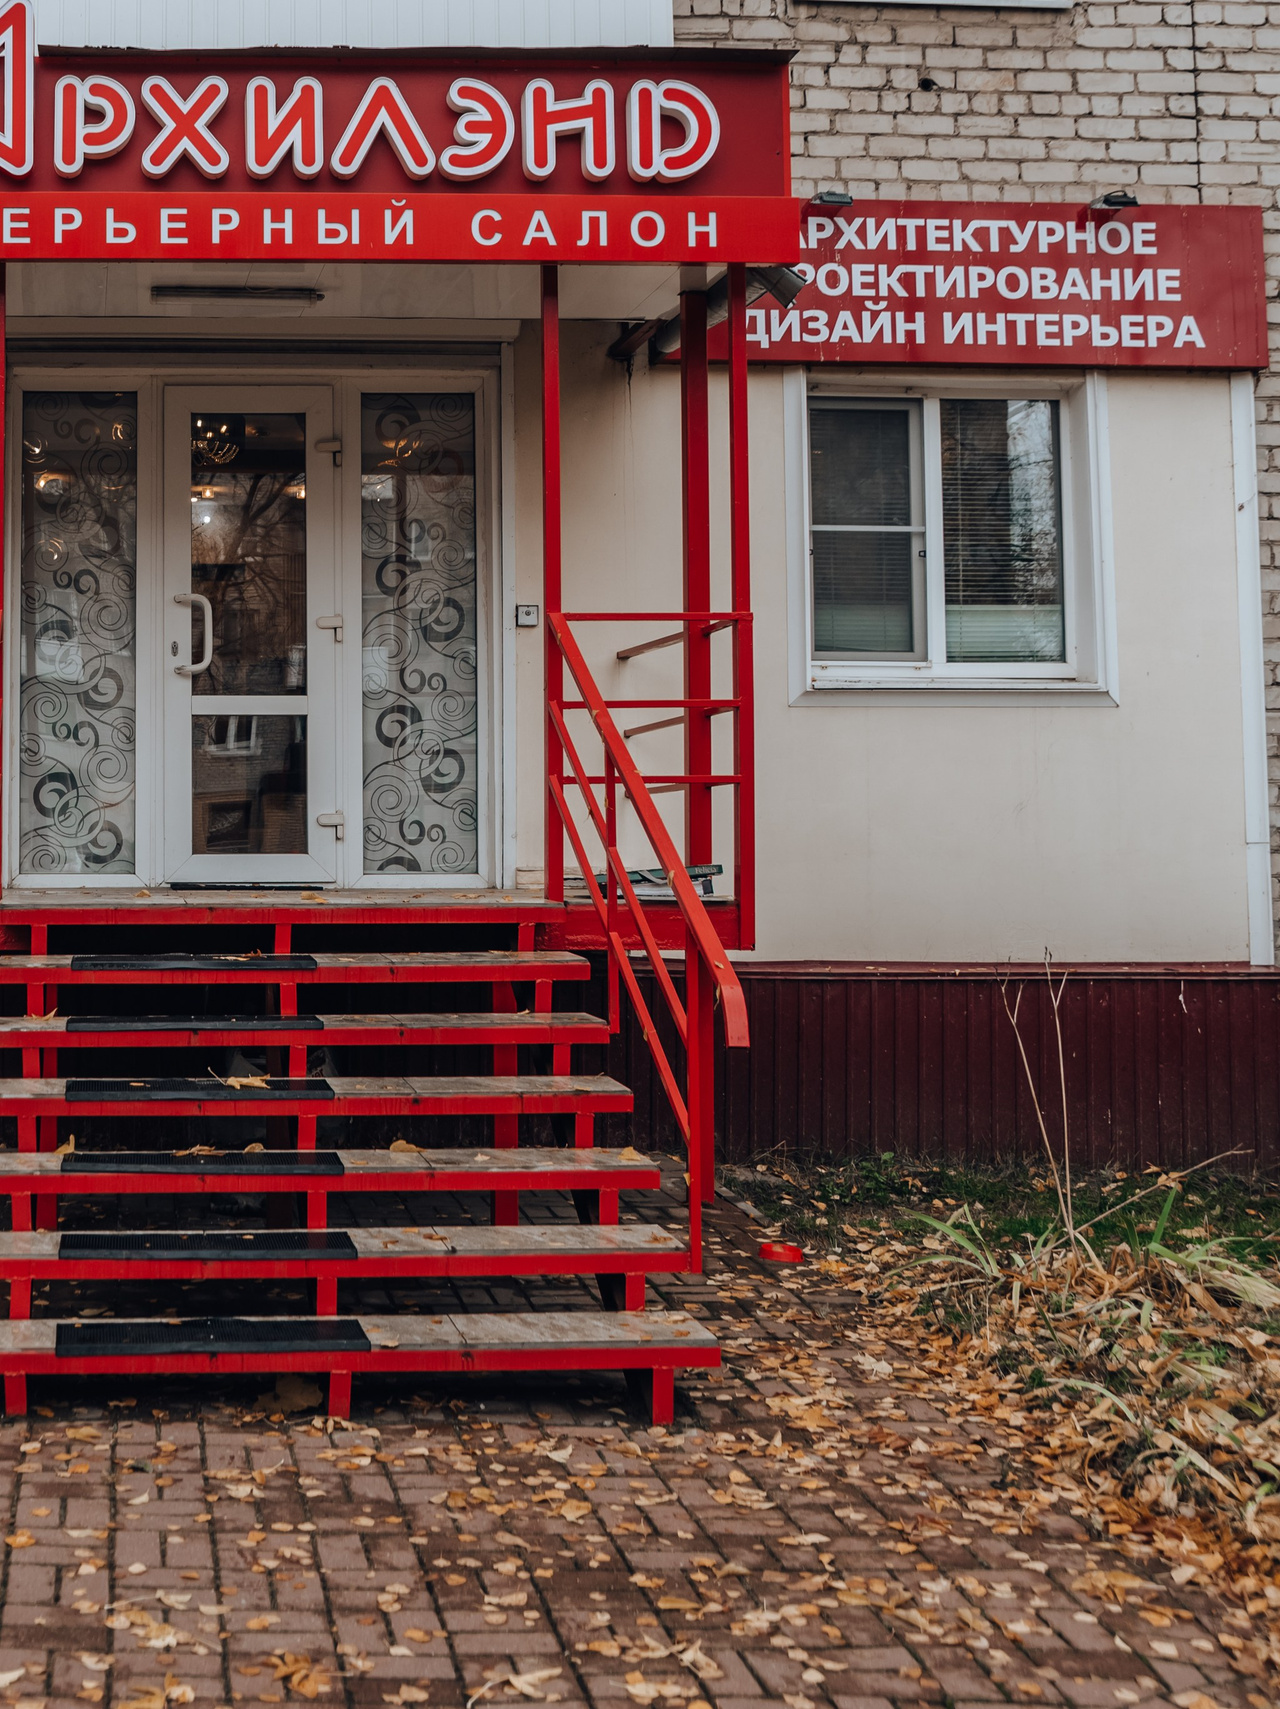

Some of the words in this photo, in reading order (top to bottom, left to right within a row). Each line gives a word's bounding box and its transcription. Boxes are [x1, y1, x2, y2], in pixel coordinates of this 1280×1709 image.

[470, 209, 718, 248] САЛОН
[799, 216, 1158, 255] РХИТЕКТУРНОЕ
[790, 262, 1182, 302] РОЕКТИРОВАНИЕ
[746, 300, 926, 349] ДИЗАЙН
[942, 311, 1207, 349] ИНТЕРЬЕРА
